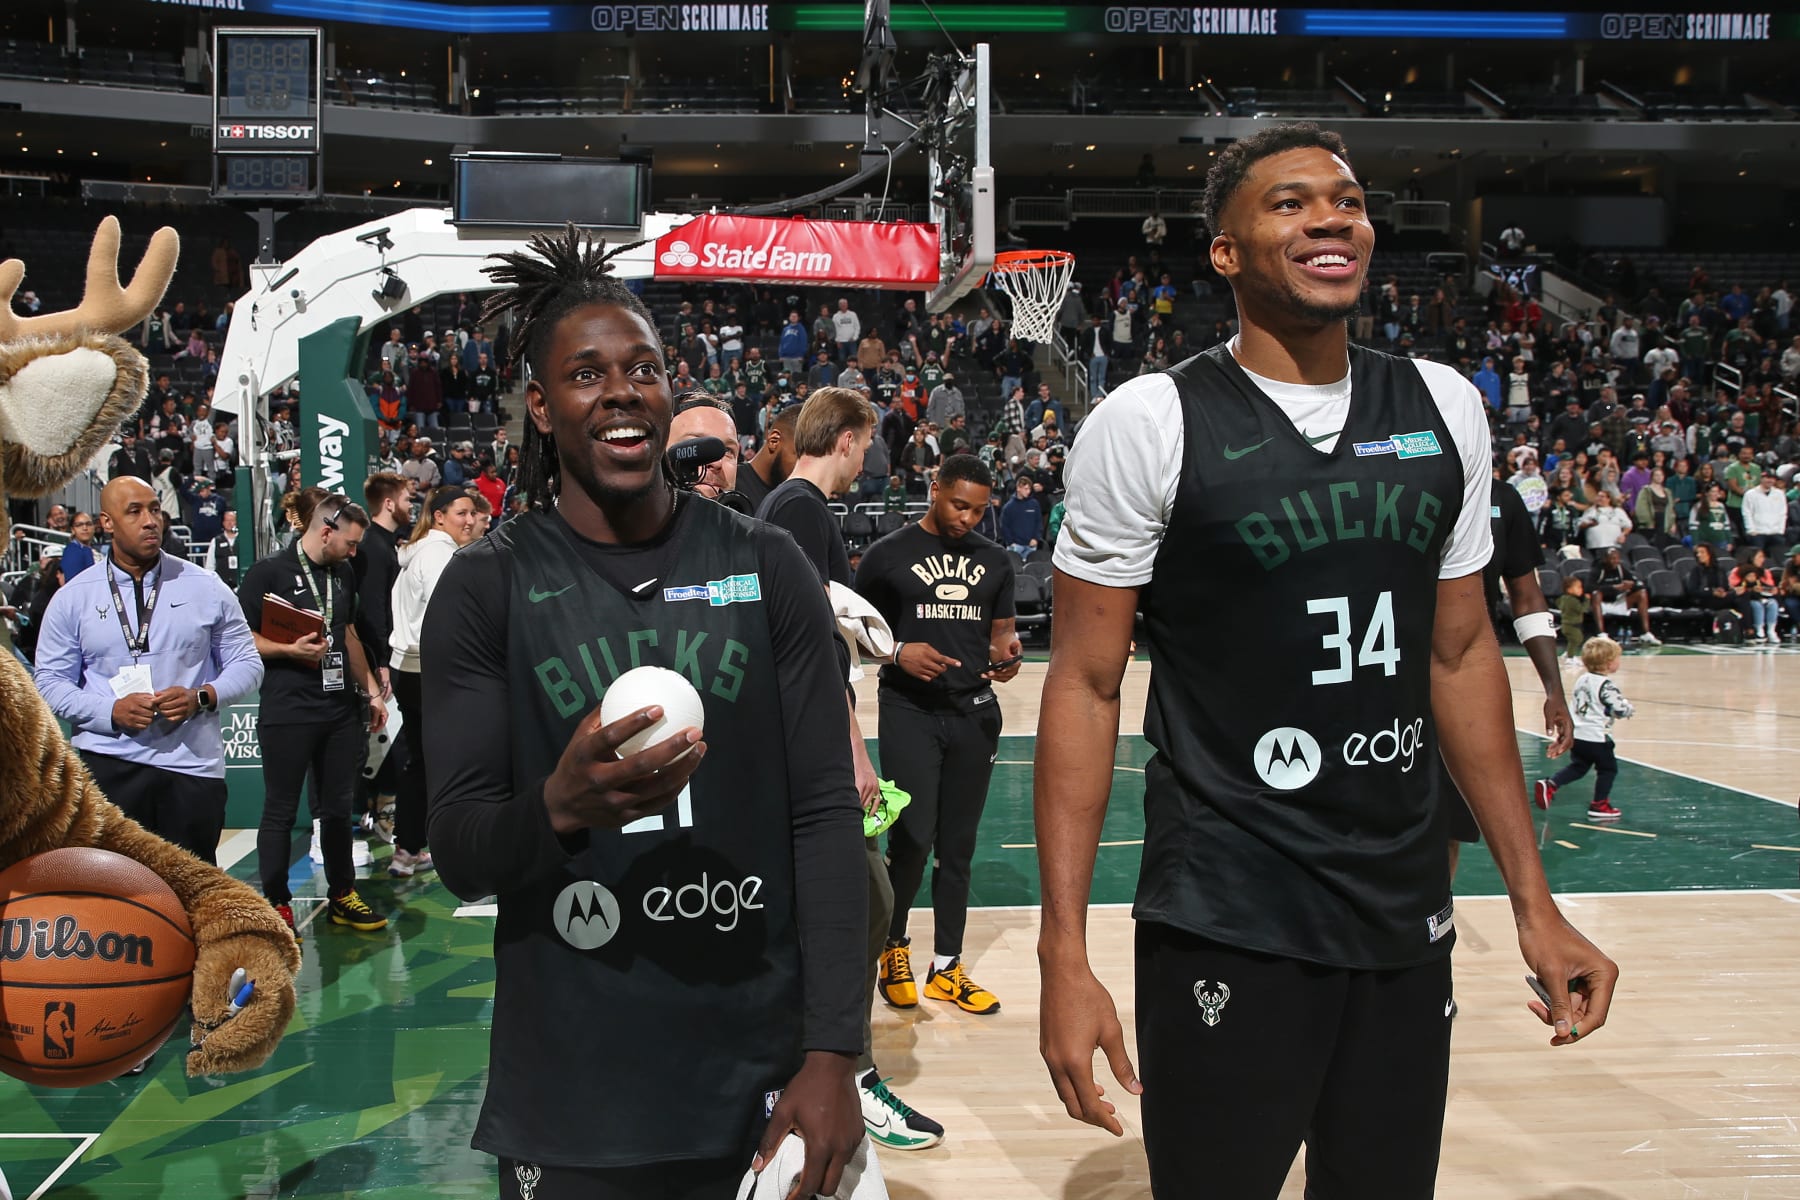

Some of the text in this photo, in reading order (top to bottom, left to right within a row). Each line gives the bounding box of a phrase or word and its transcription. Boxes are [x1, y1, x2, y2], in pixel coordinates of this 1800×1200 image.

[592, 4, 768, 31] OPEN SCRIMMAGE
[1104, 7, 1277, 34] OPEN SCRIMMAGE
[1600, 13, 1771, 40] OPEN SCRIMMAGE
[246, 125, 313, 139] TISSOT
[1356, 444, 1395, 454] Froedtert
[1235, 481, 1443, 571] BUCKS
[911, 554, 986, 586] BUCKS
[667, 588, 708, 599] Froedtert
[925, 604, 982, 621] BASKETBALL
[1306, 591, 1401, 686] 34
[1343, 718, 1423, 772] edge
[642, 871, 764, 932] edge
[0, 914, 154, 967] Wilson
